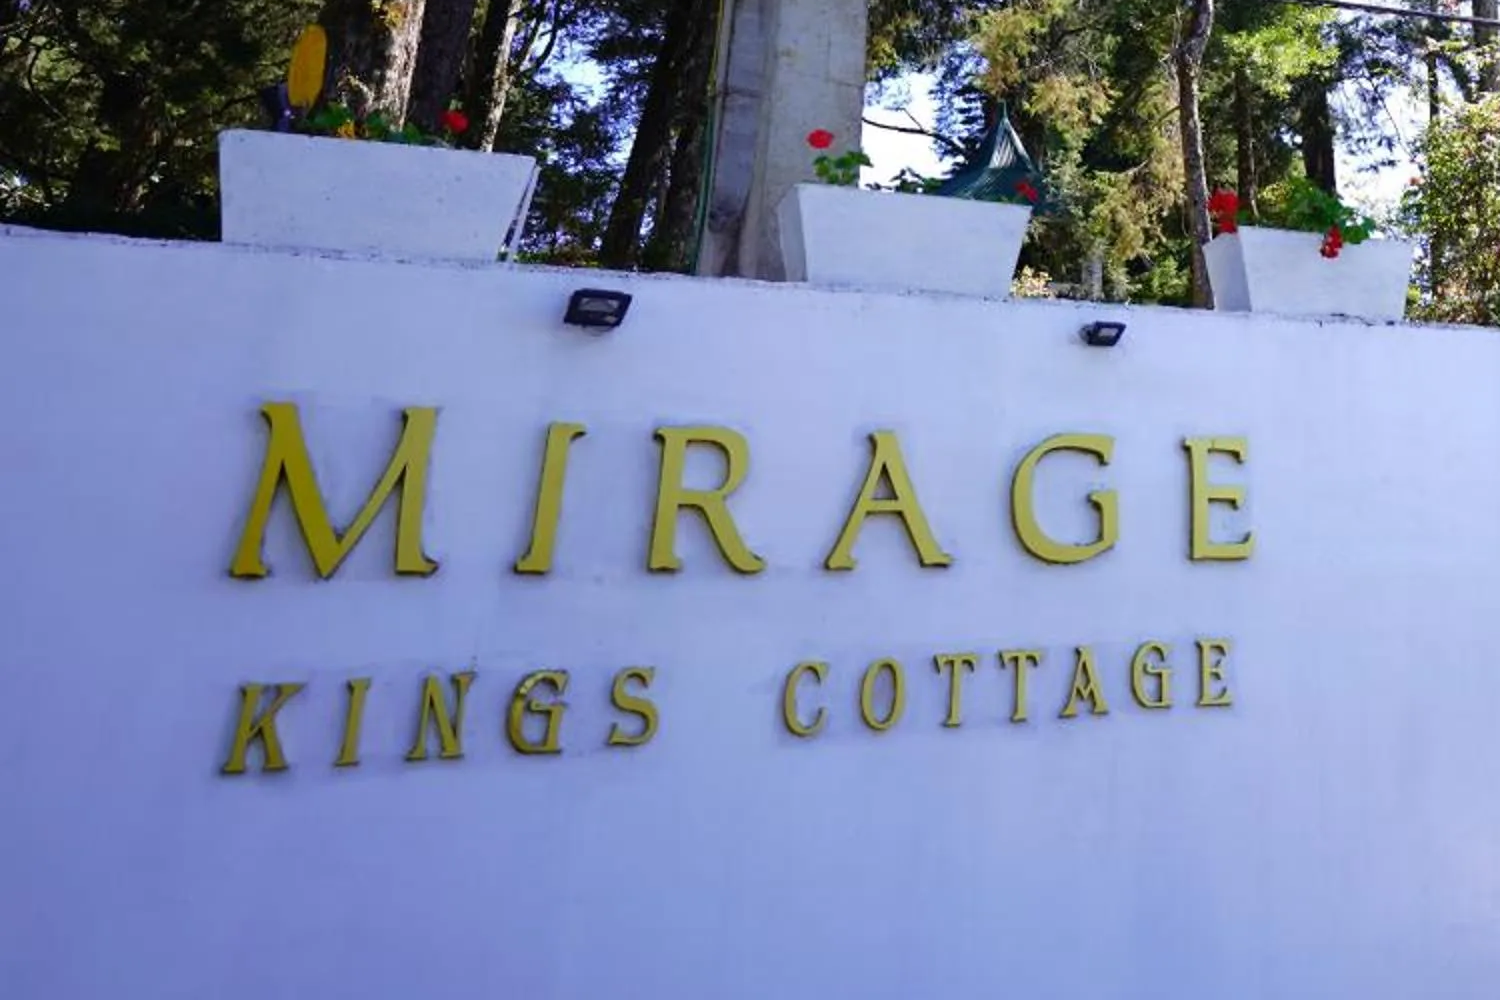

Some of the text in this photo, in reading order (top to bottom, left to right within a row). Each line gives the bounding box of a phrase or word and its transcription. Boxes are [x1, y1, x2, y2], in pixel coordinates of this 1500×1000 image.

[229, 400, 1257, 581] MIRAGE
[217, 637, 1235, 777] KINGS COTTAGE
